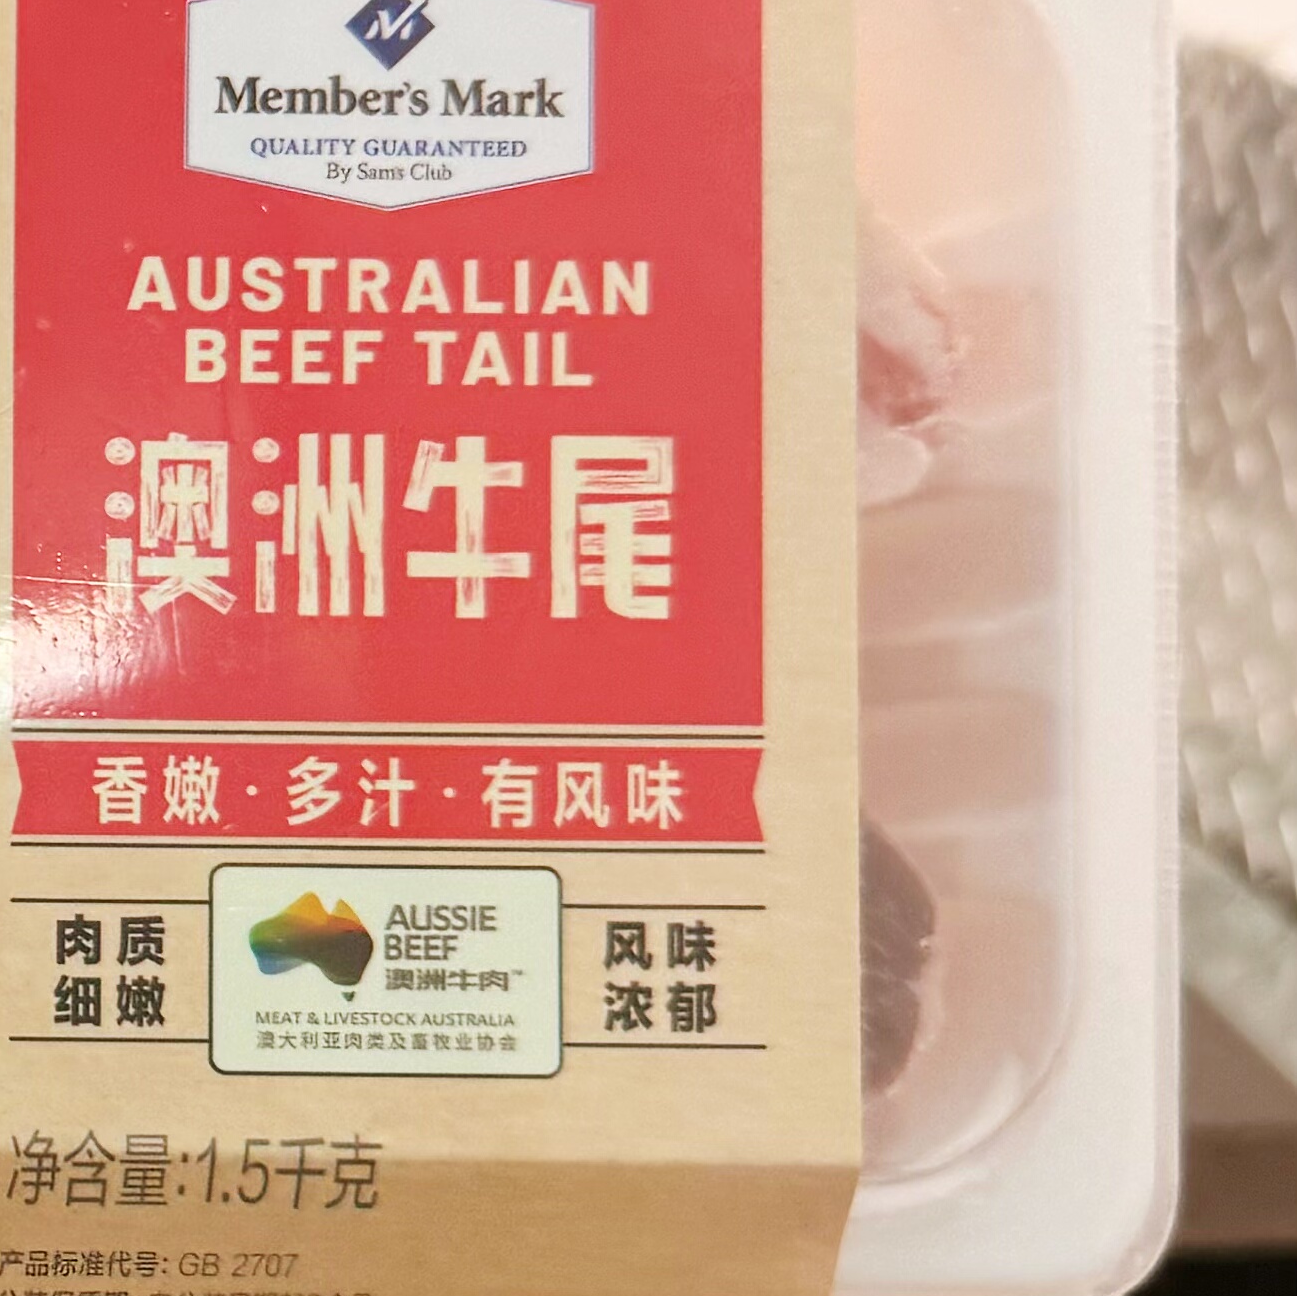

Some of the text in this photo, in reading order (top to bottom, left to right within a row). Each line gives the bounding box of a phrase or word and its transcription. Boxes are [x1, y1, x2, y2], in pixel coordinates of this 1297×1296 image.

[214, 74, 565, 118] Member's Mark
[250, 137, 528, 159] QUALITY GUARANTEED
[326, 162, 352, 183] By
[410, 163, 452, 180] Club
[127, 256, 651, 315] AUSTRALIAN
[185, 328, 594, 386] BEEF TAIL
[104, 432, 674, 619] 澳洲牛尾
[55, 914, 166, 966] 肉质
[384, 904, 497, 931] AUSSIE
[384, 934, 458, 960] BEEF
[604, 921, 717, 972] 风味
[54, 976, 166, 1028] 细嫩
[256, 1011, 515, 1027] MEAT & LIVESTOCK AUSTRALIA
[604, 983, 718, 1034] 浓郁
[6, 1129, 383, 1210] 净含量:1.5千克
[179, 1253, 220, 1277] GB
[231, 1253, 299, 1278] 2707
